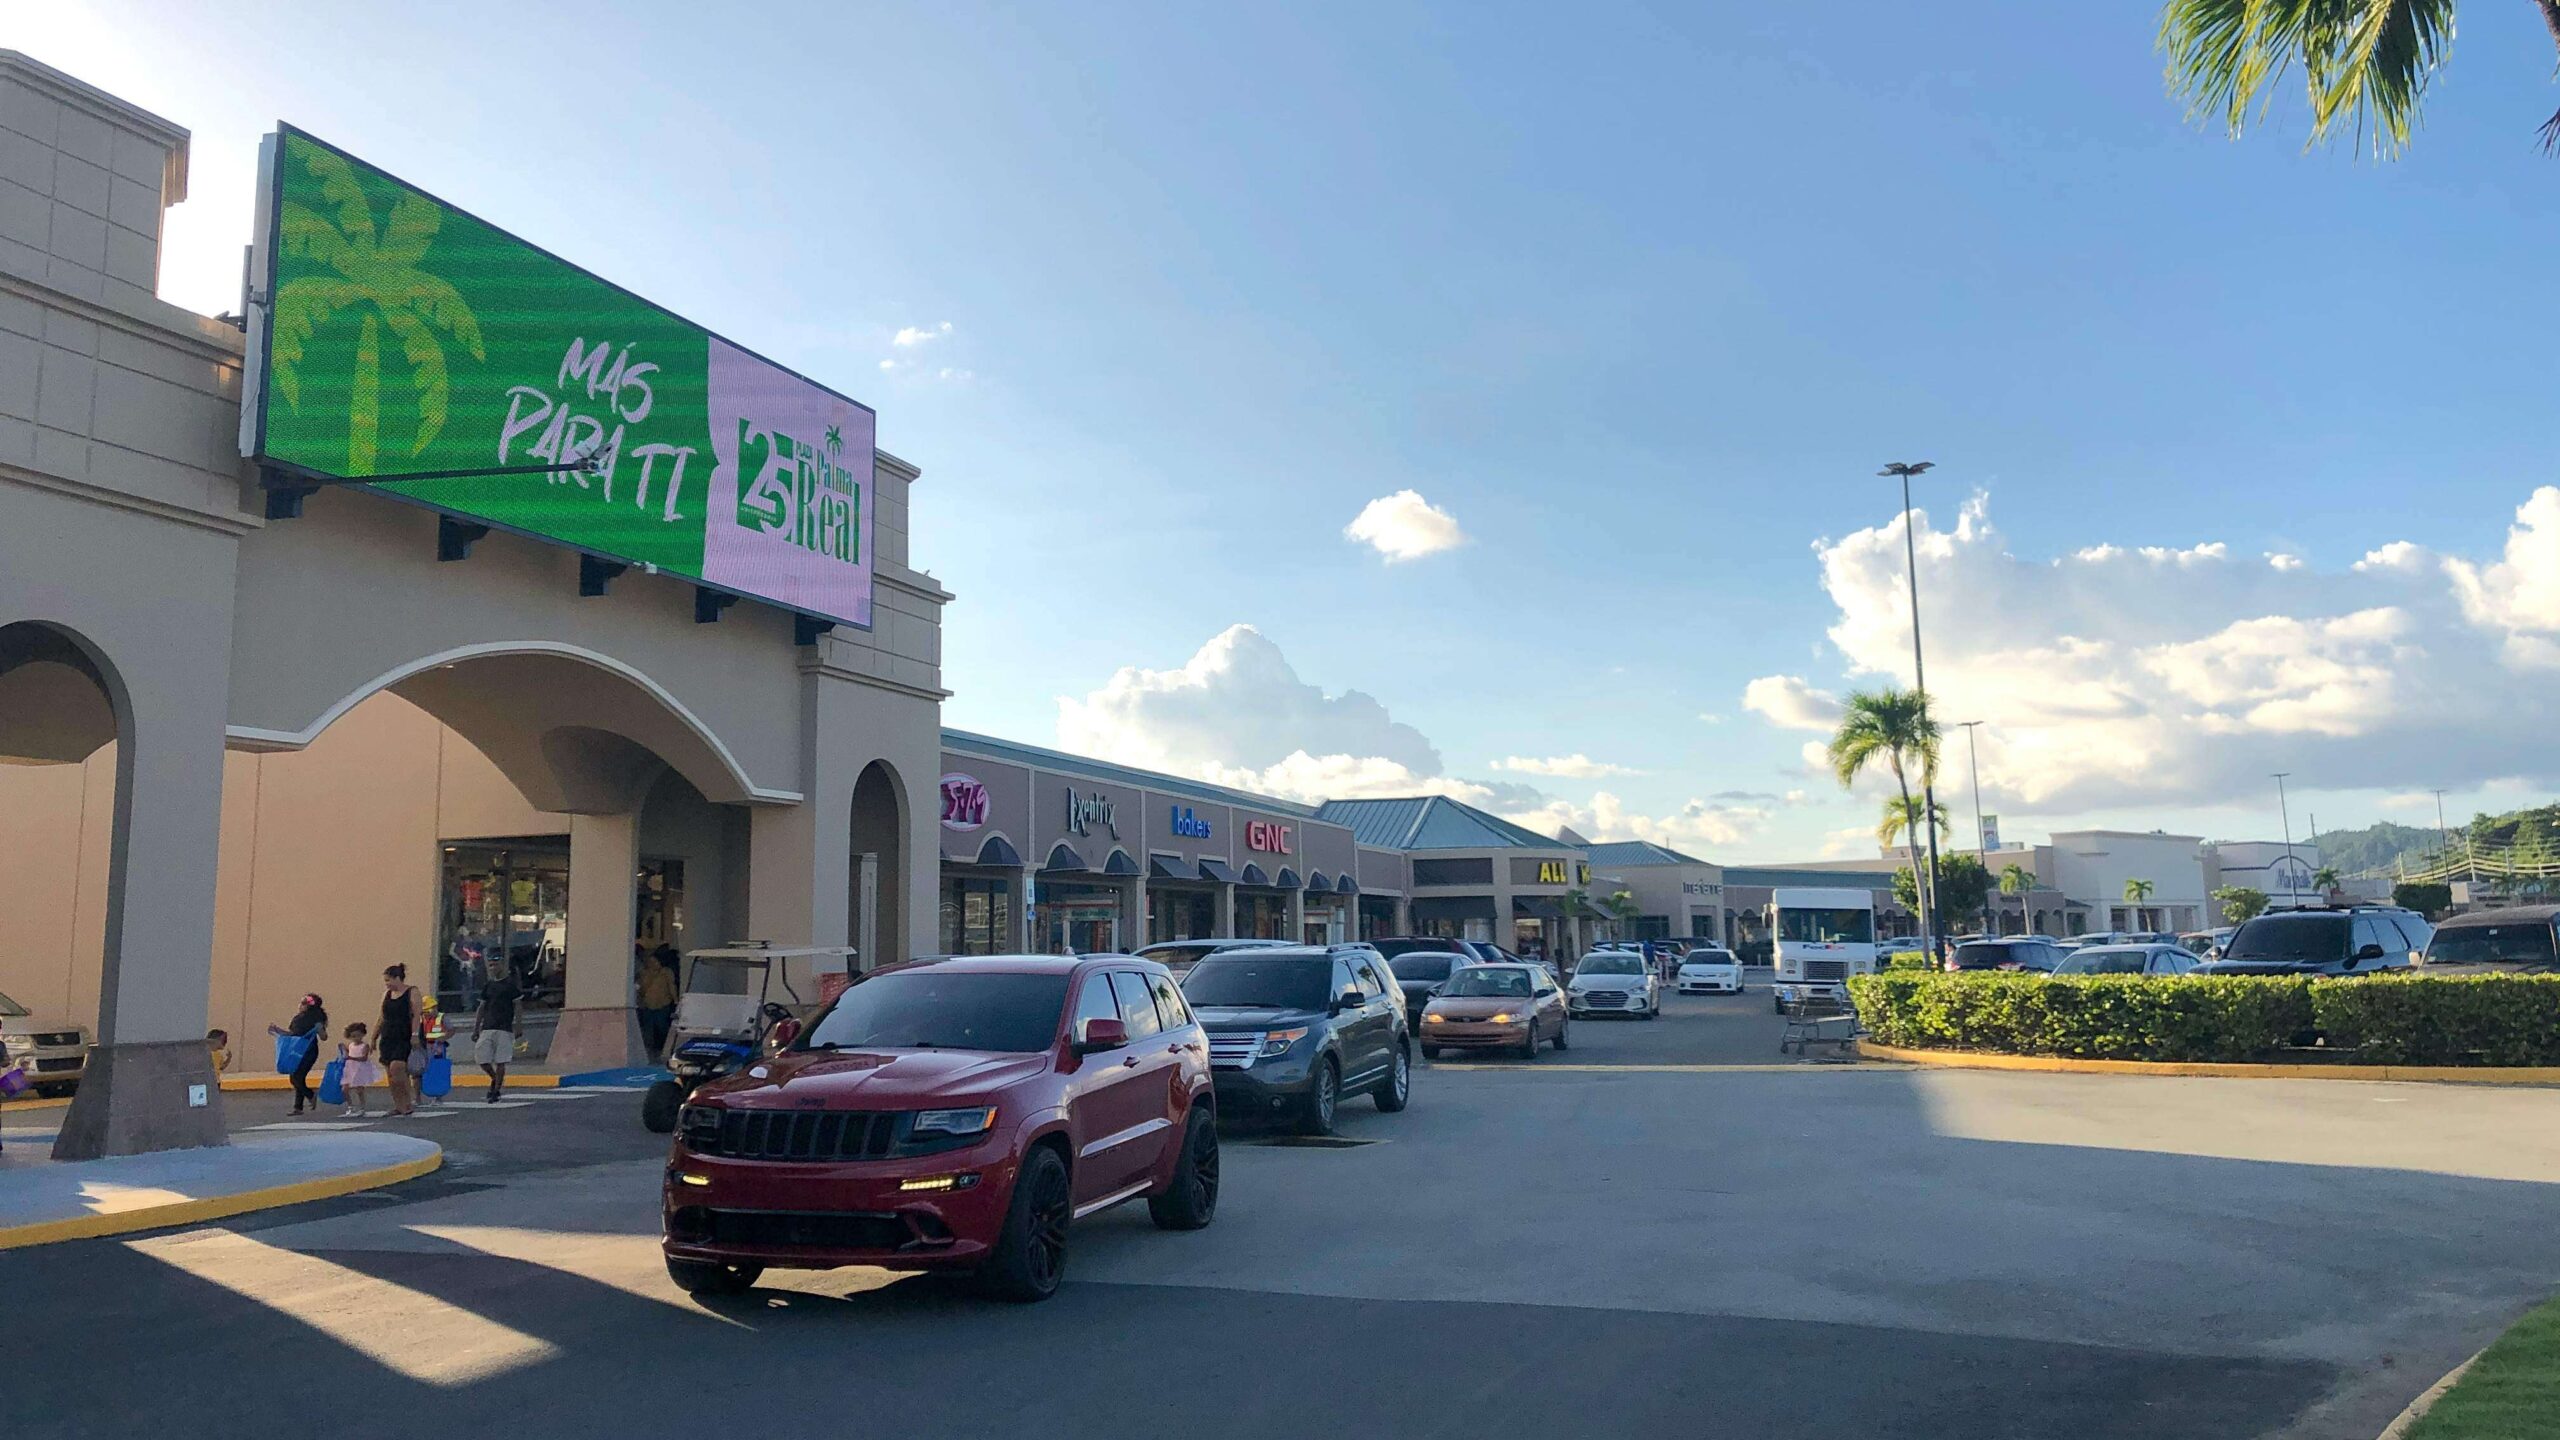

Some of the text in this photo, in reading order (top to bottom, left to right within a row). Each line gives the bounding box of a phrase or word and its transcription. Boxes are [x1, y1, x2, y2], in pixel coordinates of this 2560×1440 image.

[557, 336, 661, 424] MÁS
[498, 385, 698, 522] PARA TI
[738, 418, 793, 543] 25
[816, 449, 853, 487] Palma
[795, 458, 861, 565] Real
[1068, 786, 1119, 840] Exentrix
[1172, 805, 1213, 839] bakers
[1246, 821, 1293, 855] GNC
[1539, 862, 1568, 883] ALL
